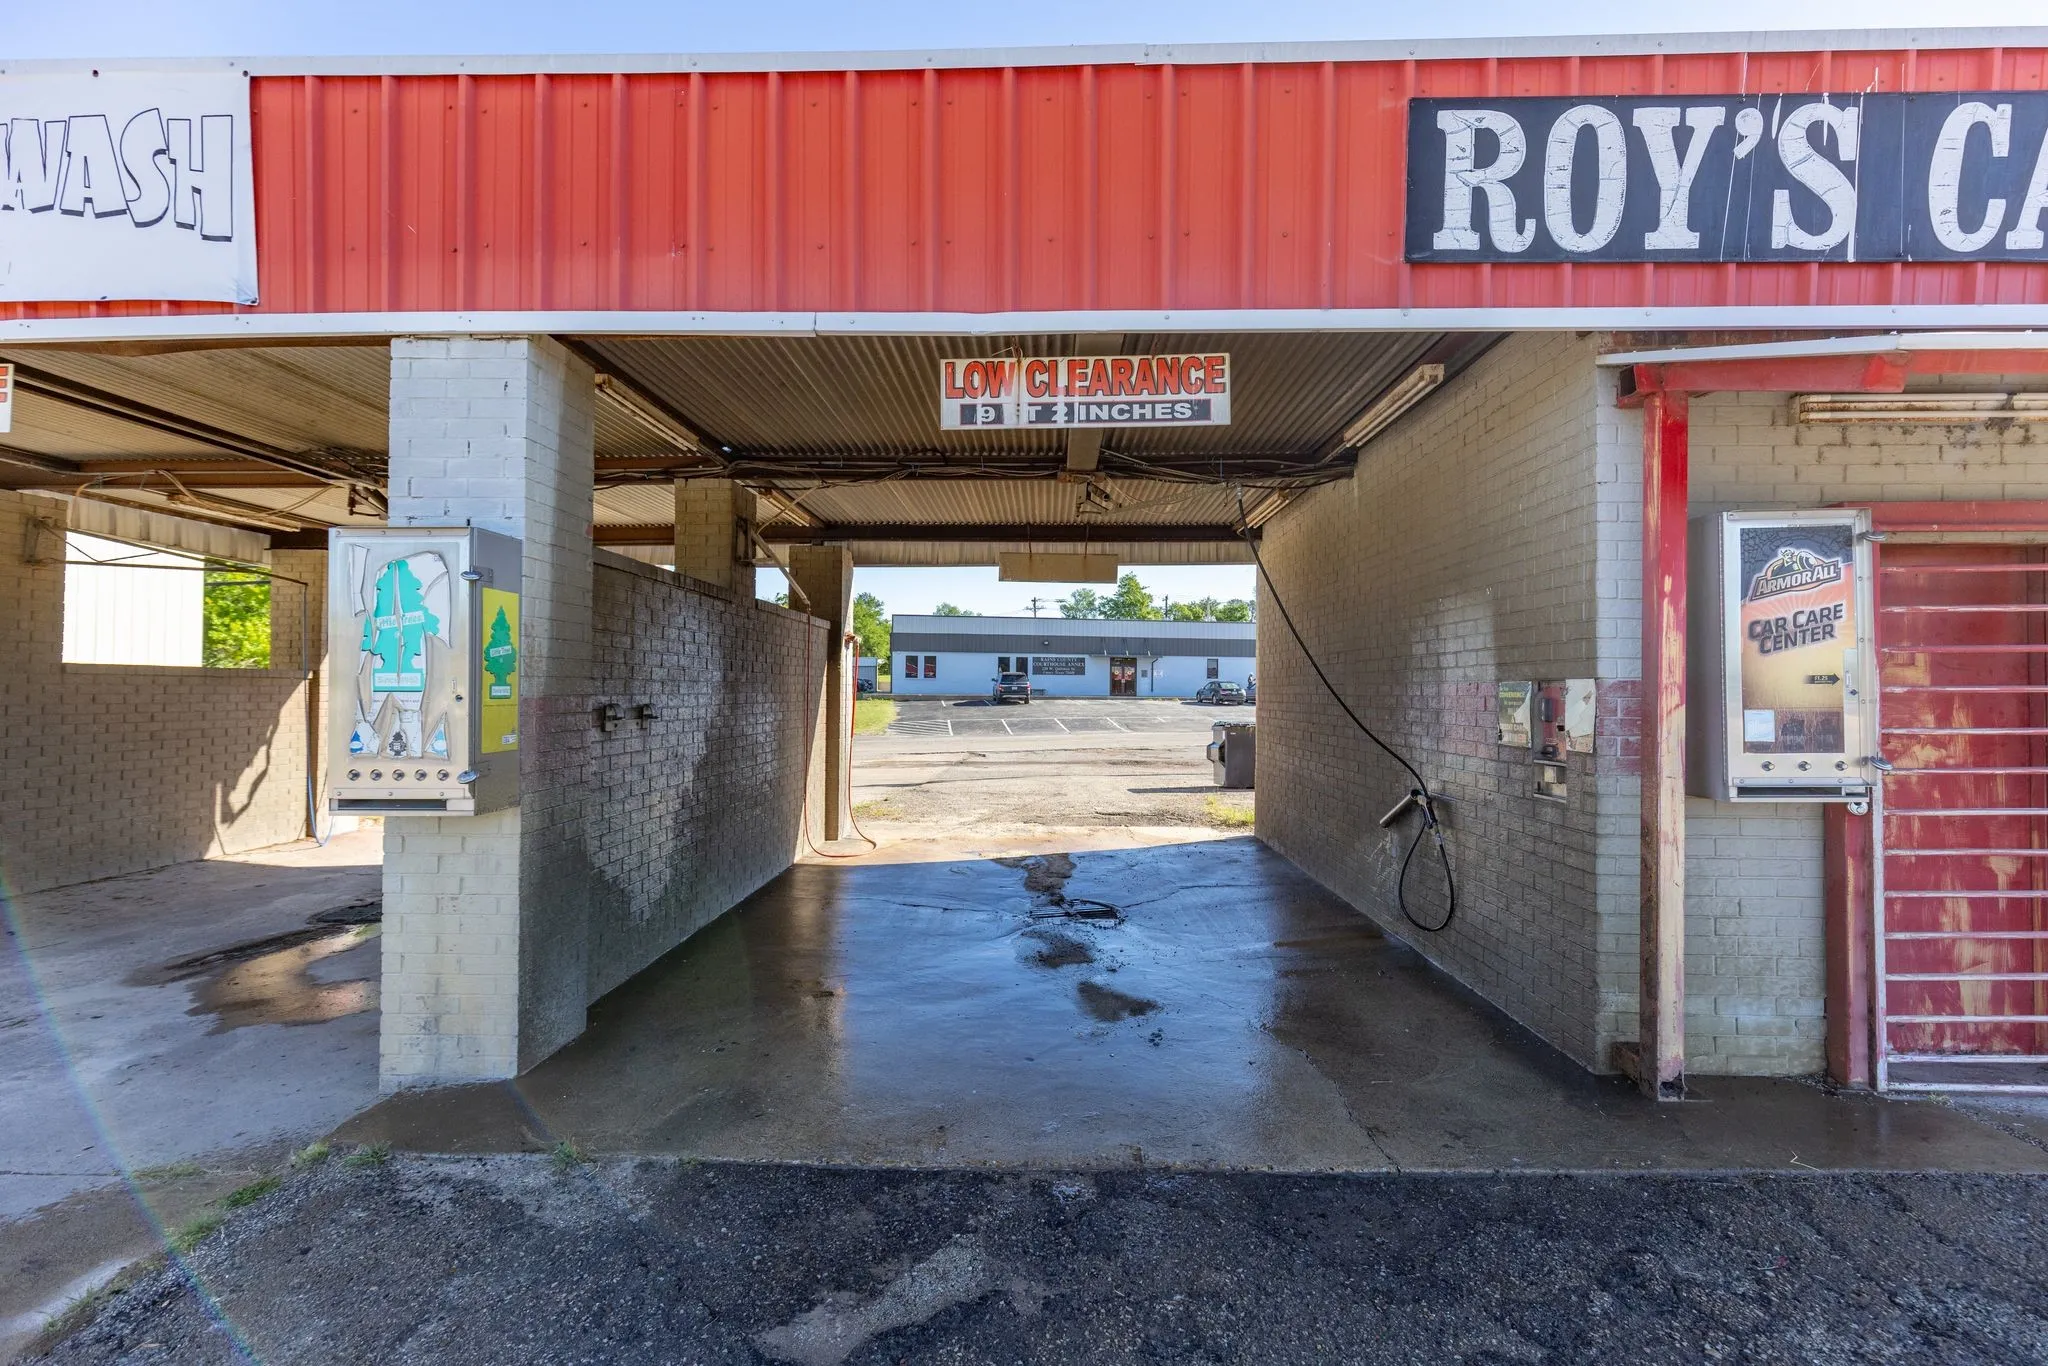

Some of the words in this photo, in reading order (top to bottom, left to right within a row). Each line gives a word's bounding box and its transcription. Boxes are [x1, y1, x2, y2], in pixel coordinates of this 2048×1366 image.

[0, 108, 233, 242] WASH
[1433, 104, 1858, 253] ROY'S
[945, 360, 1016, 399] LOW
[1025, 355, 1226, 398] CLEARANCE
[1051, 405, 1068, 421] 2
[1079, 402, 1193, 421] INCHES
[1748, 616, 1789, 640] CAR
[1792, 603, 1844, 629] CARE
[1759, 623, 1836, 654] CENTER
